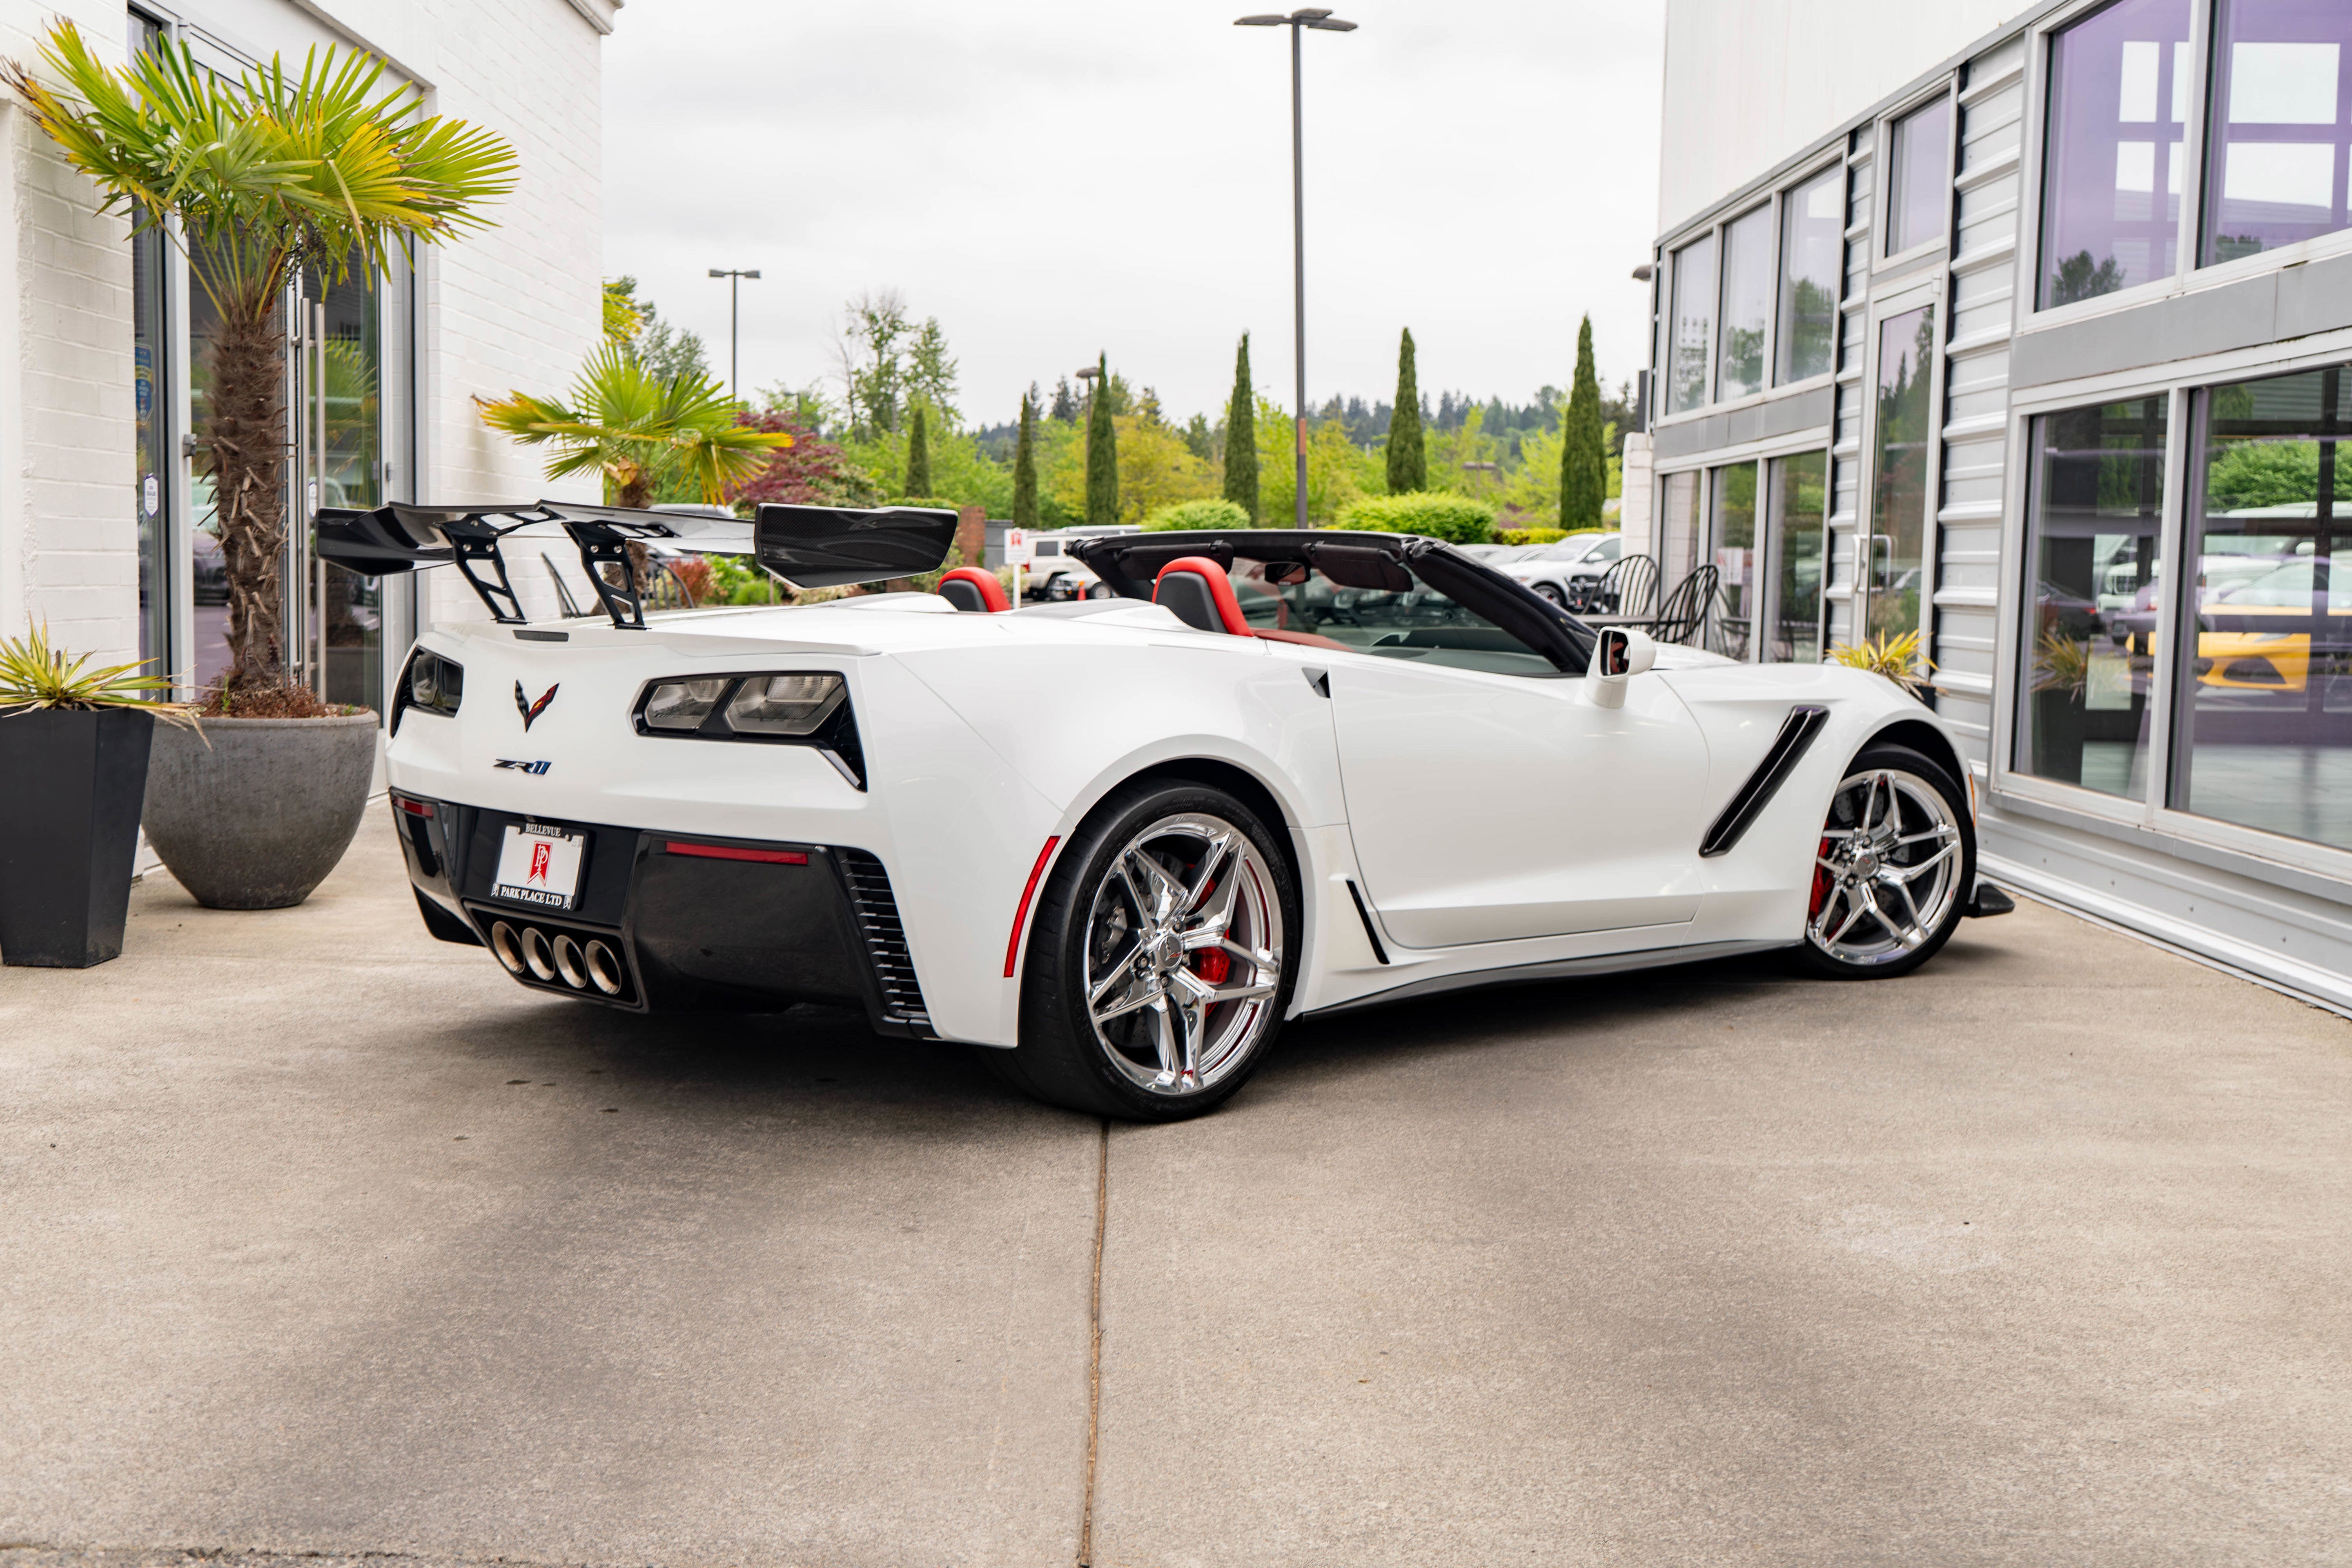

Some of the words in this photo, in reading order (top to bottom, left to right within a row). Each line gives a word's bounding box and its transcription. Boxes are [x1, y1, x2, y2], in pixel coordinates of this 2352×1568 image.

[525, 823, 561, 837] BELLEVUE
[500, 886, 521, 899] PARK
[520, 889, 546, 904] PLACE
[545, 893, 563, 906] LTD
